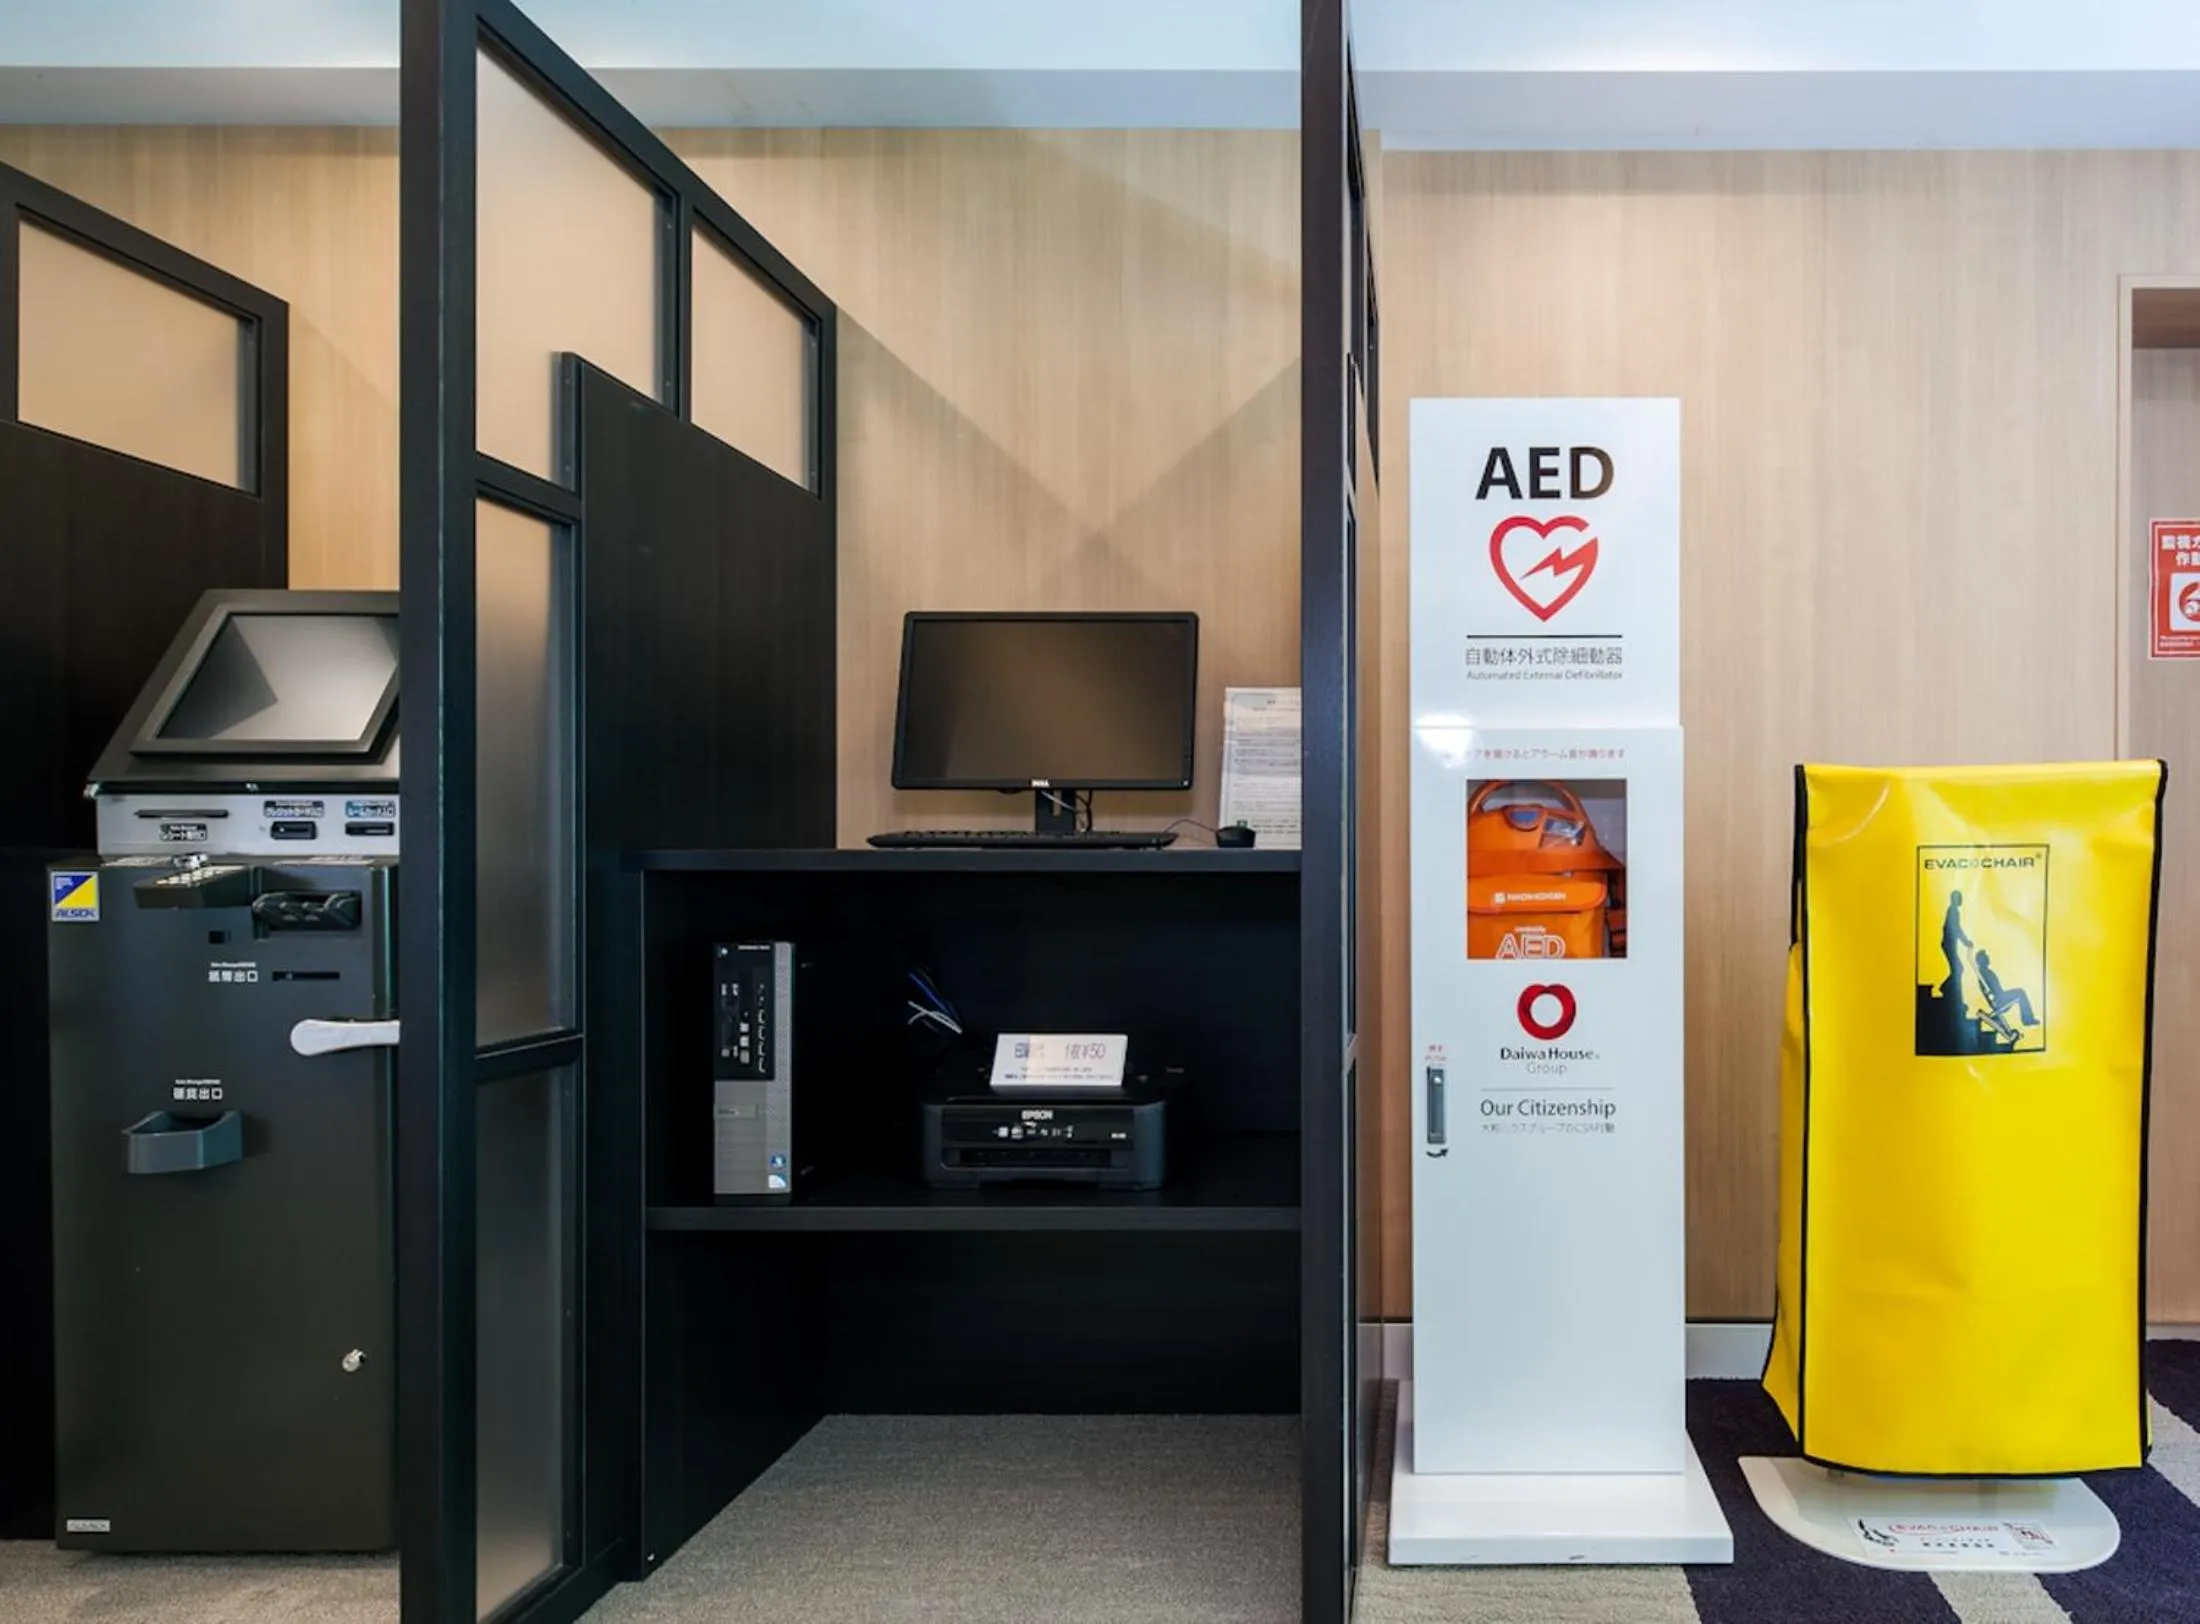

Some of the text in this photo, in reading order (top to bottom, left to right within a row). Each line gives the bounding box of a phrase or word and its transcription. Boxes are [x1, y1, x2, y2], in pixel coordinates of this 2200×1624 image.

[1475, 446, 1615, 500] AED
[1466, 646, 1623, 666] 自動体外式除細動器
[1466, 670, 1623, 681] Automated External Defibrillator
[1495, 933, 1566, 960] AED
[1500, 1046, 1595, 1061] Daiwa House
[1525, 1062, 1568, 1077] Group
[1021, 1109, 1054, 1121] EPSON
[1480, 1098, 1617, 1119] Our Citizenship
